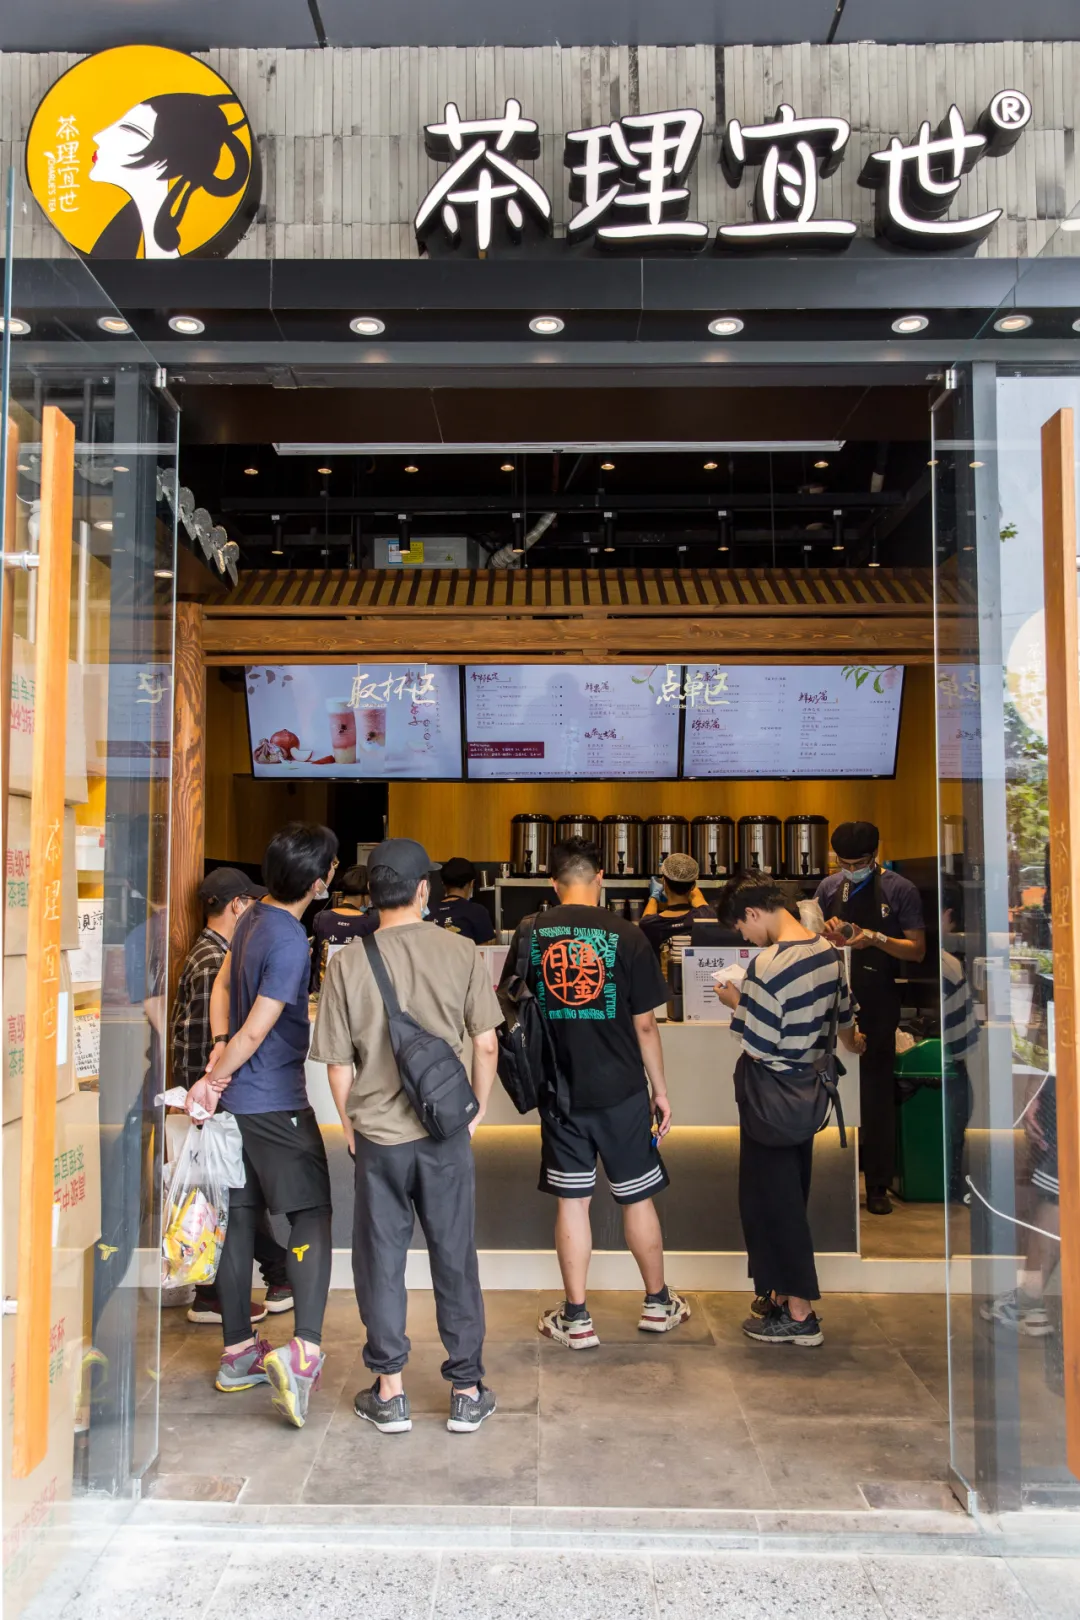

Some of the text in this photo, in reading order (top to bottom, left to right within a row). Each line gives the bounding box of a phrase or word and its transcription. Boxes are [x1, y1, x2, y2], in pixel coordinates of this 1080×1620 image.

[55, 115, 80, 213] 茶理宜世
[48, 197, 57, 213] TEA
